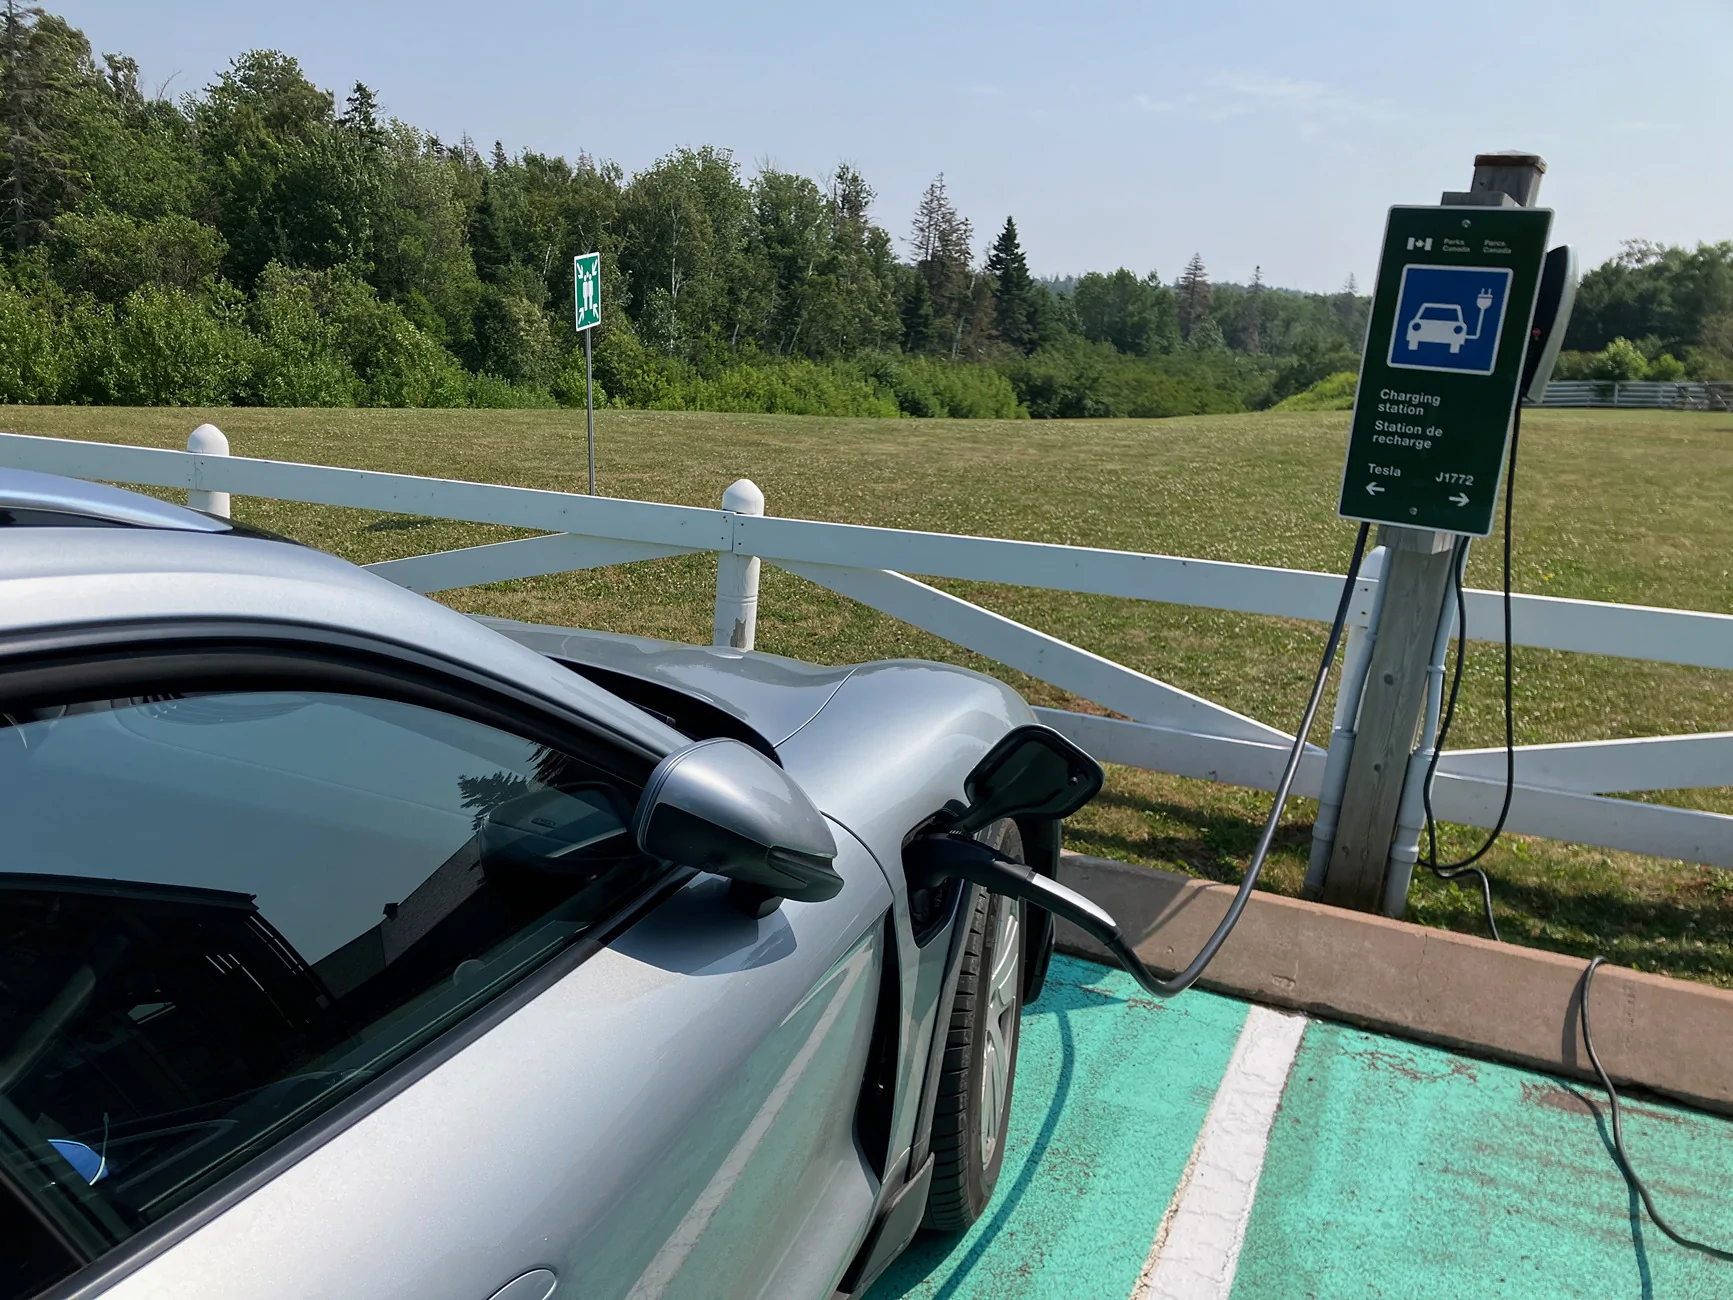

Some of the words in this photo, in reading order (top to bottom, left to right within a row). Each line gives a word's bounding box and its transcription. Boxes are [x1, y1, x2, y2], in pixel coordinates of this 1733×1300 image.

[1443, 245, 1470, 253] Canada
[1380, 388, 1441, 407] Charging
[1378, 402, 1424, 416] station
[1375, 420, 1422, 435] Station
[1426, 426, 1443, 437] de
[1373, 434, 1432, 450] recharge
[1368, 463, 1401, 477] Tesla
[1435, 472, 1474, 486] J1772
